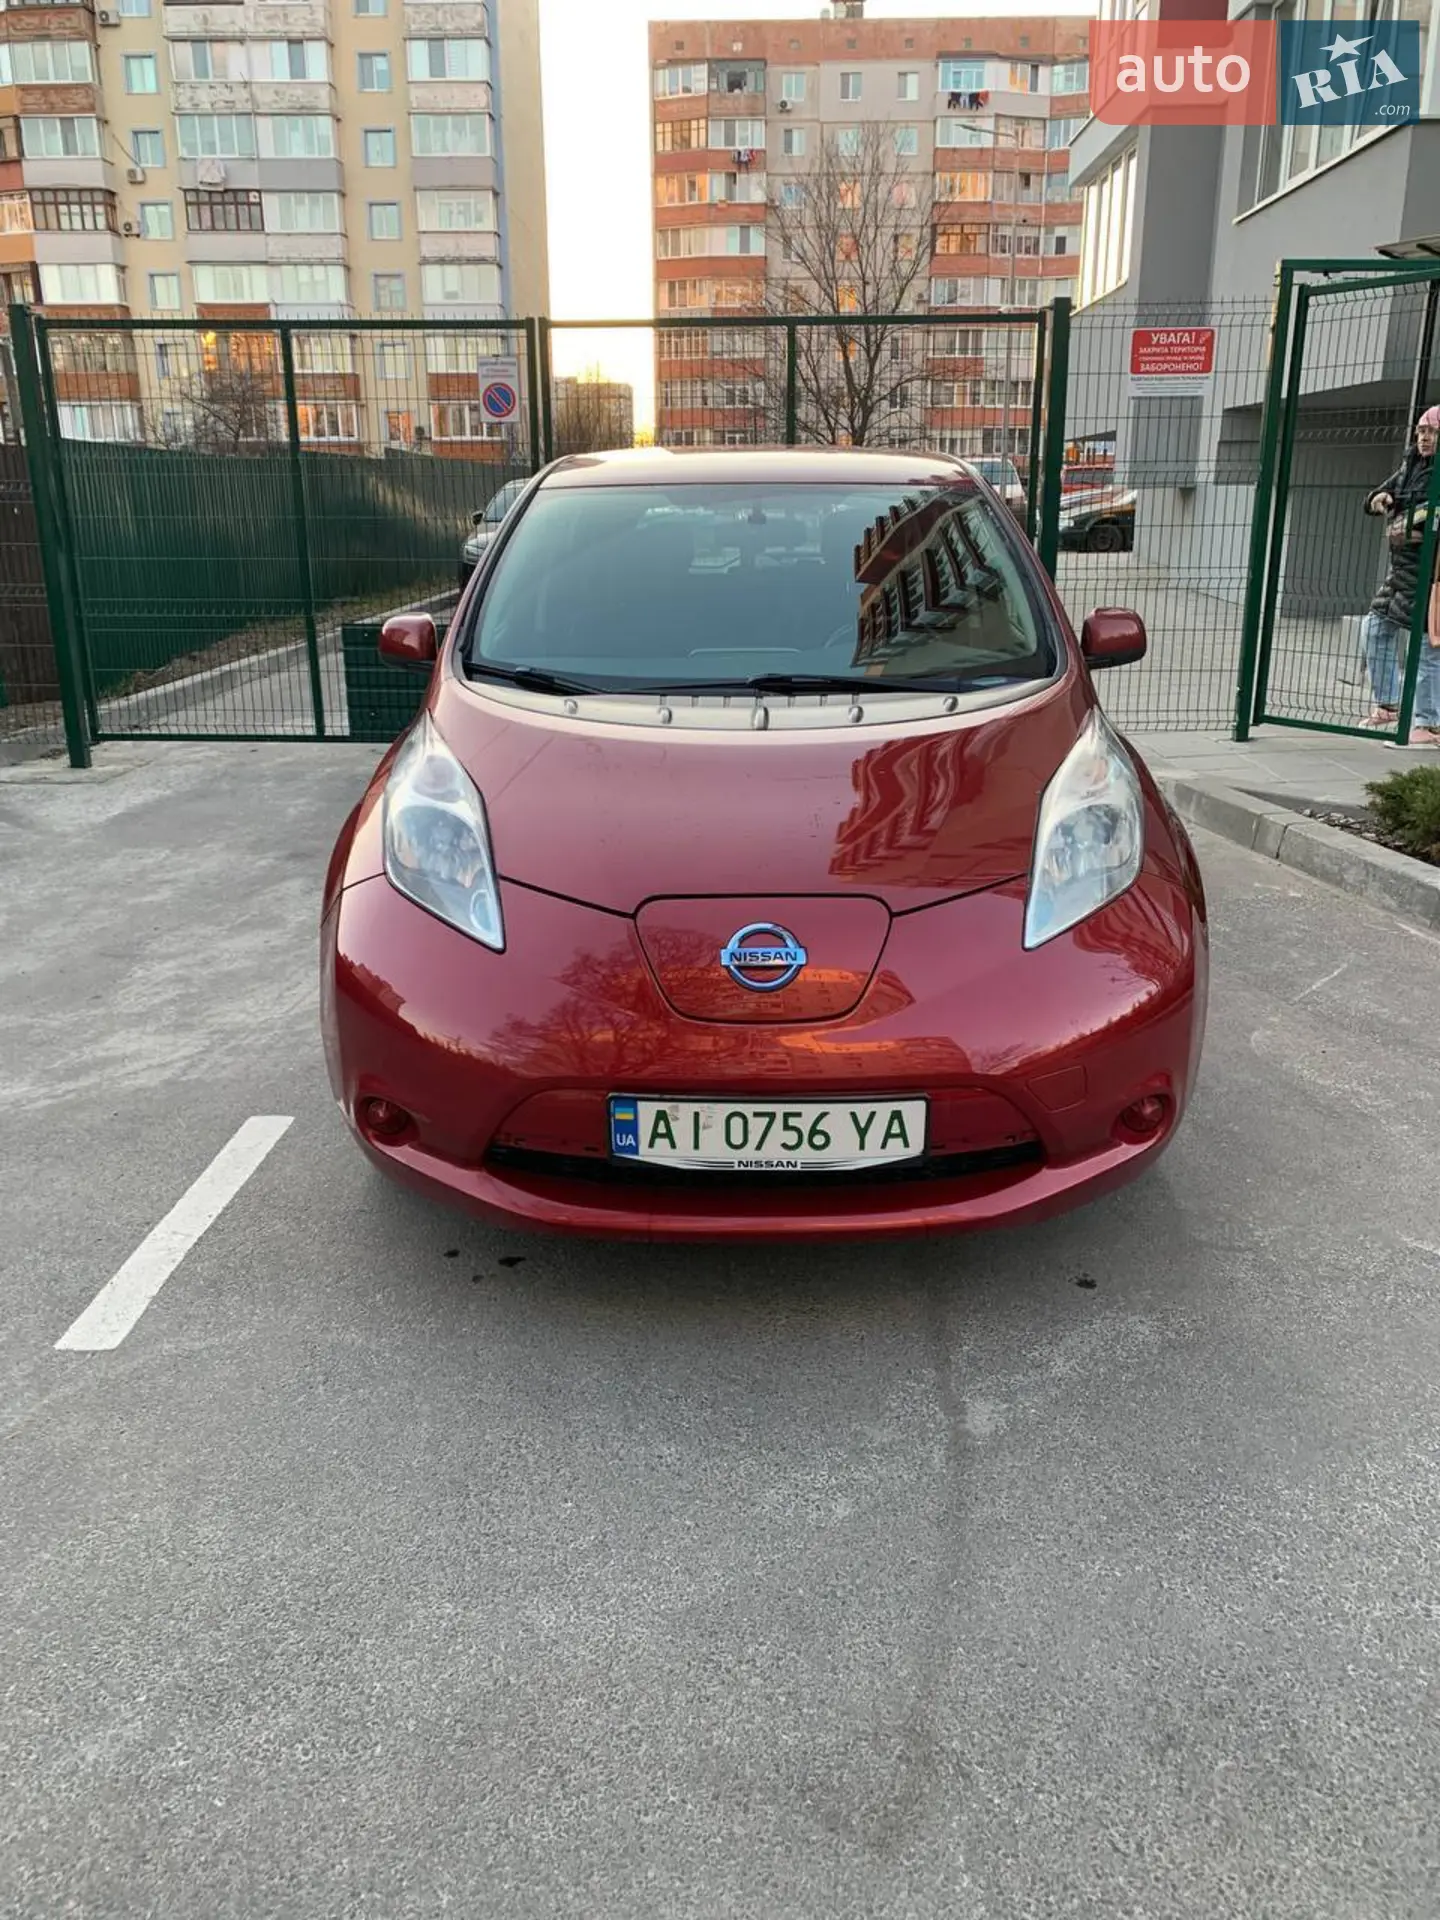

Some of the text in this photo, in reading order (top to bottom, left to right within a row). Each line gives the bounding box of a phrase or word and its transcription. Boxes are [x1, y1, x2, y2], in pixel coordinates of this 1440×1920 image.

[1151, 332, 1196, 344] УВАГА!
[1140, 362, 1203, 372] ЗАБОРОНЕНО!
[729, 951, 797, 962] NISSAN
[648, 1109, 910, 1151] AI 0756 YA
[616, 1133, 636, 1147] UA
[737, 1159, 799, 1169] NISSAN
